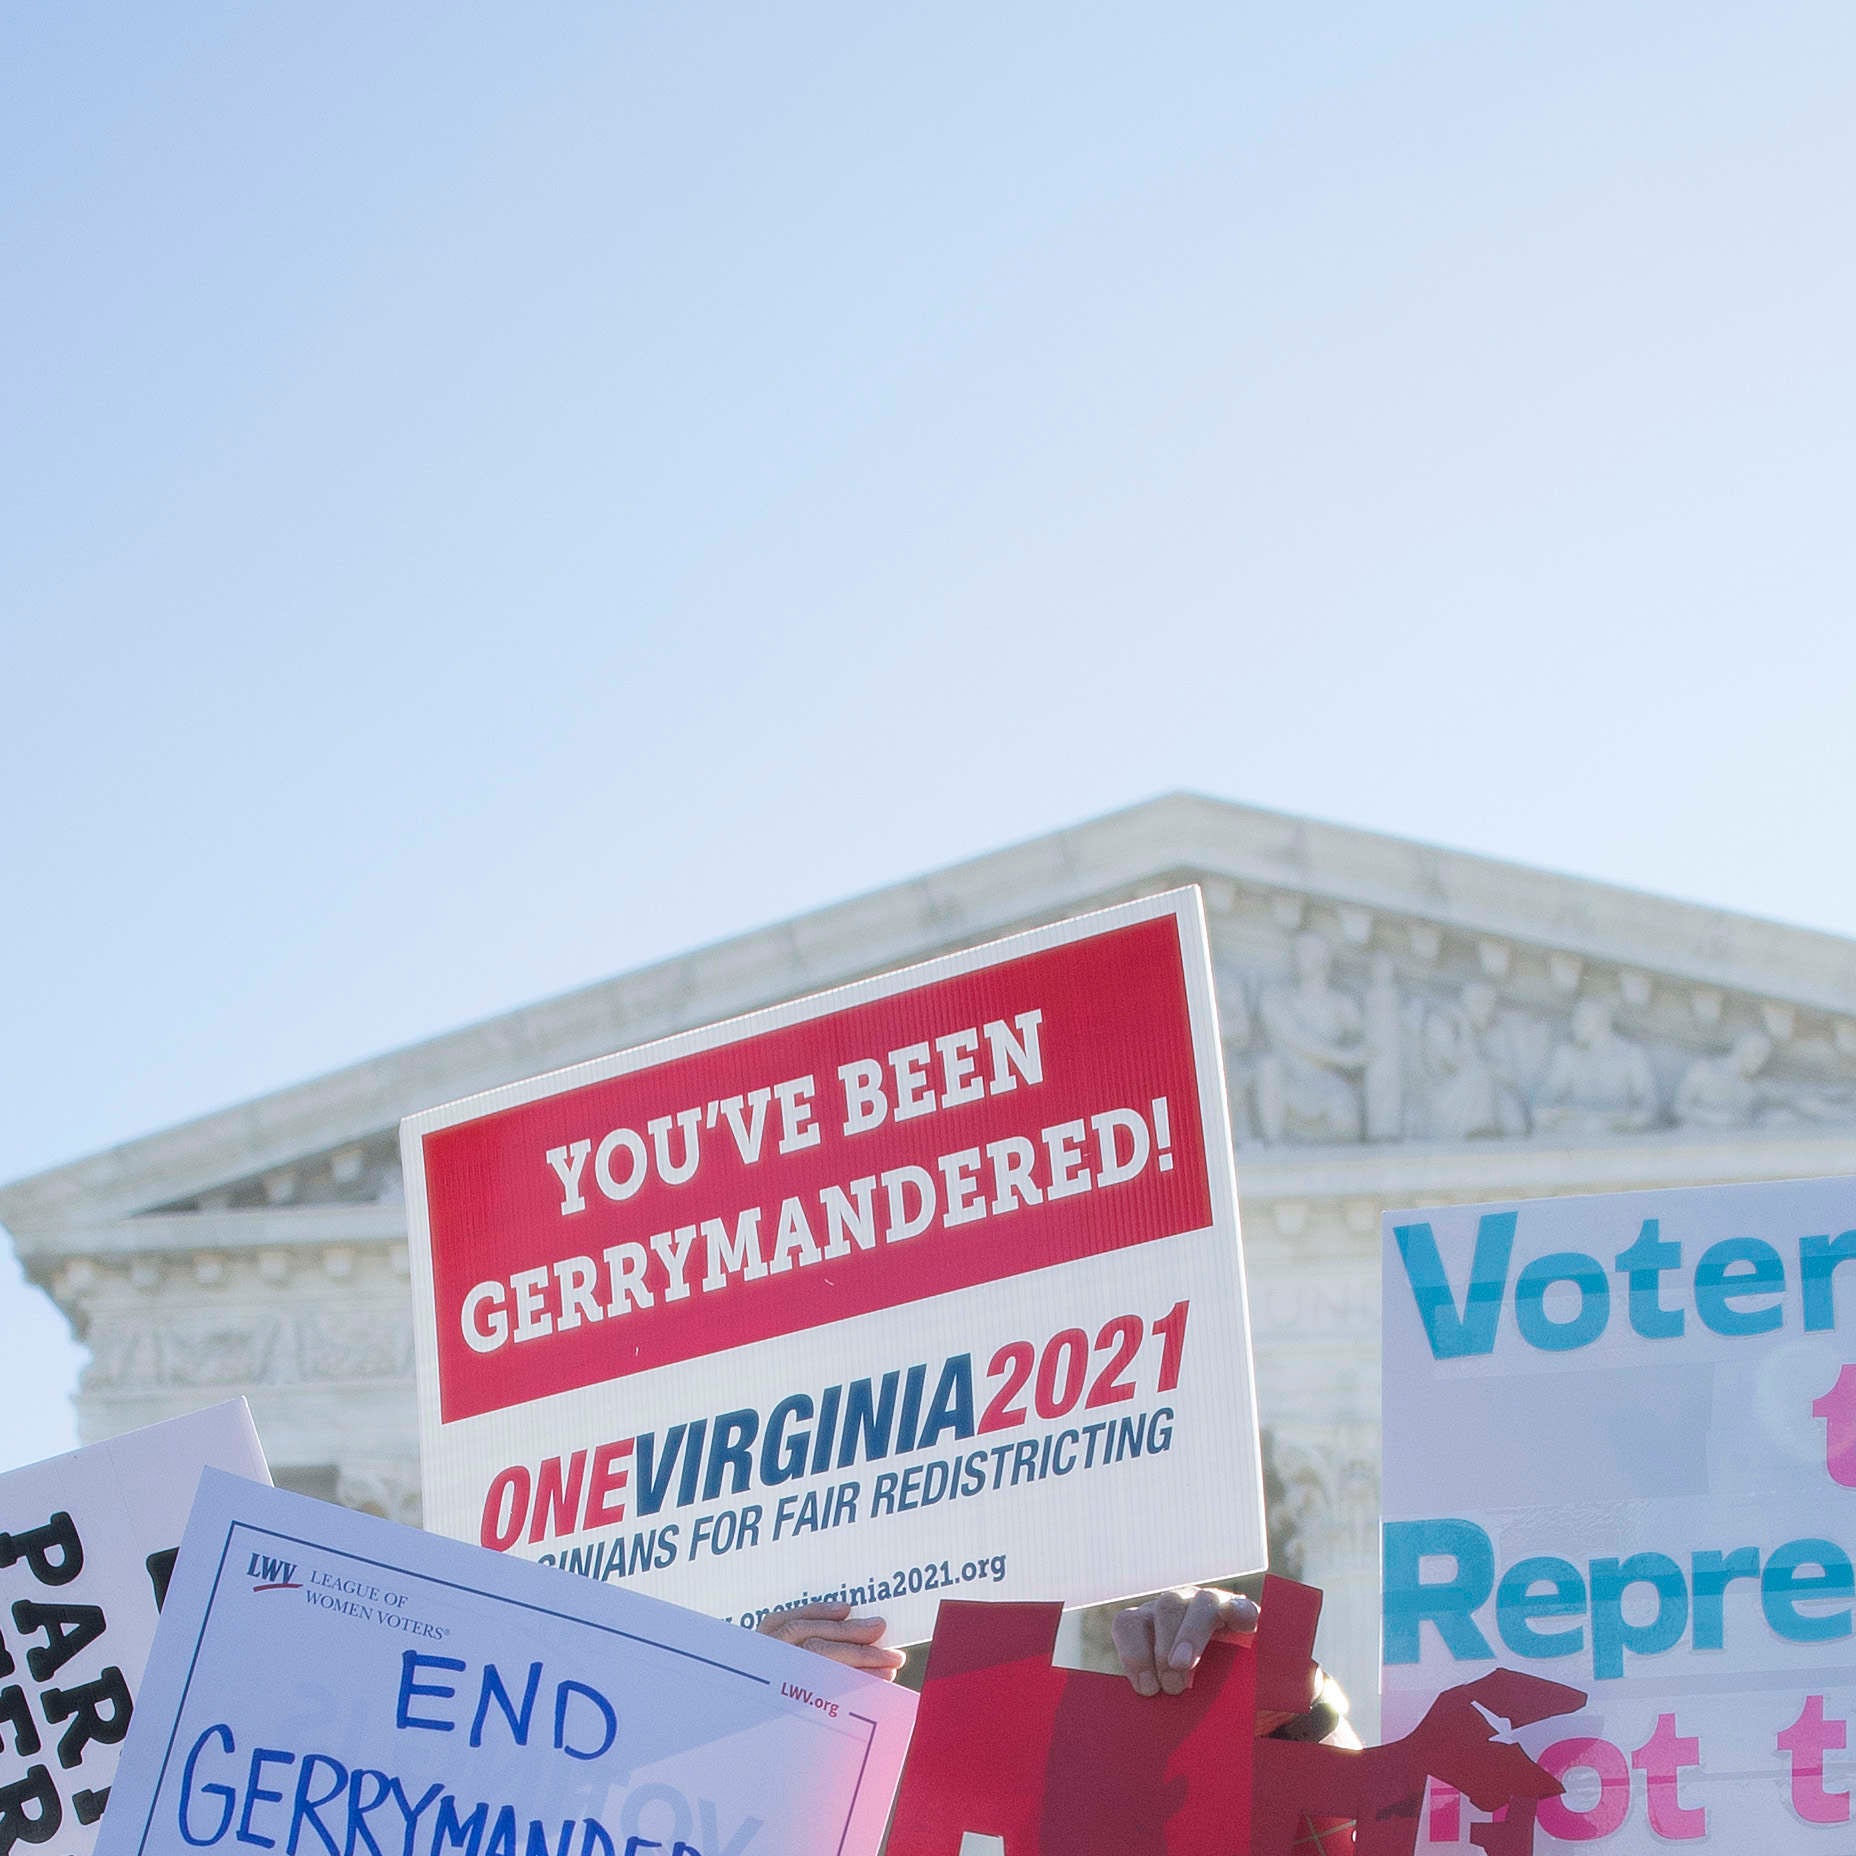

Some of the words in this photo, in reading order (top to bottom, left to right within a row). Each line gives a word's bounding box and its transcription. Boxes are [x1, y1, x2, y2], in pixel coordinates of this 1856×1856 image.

[546, 1075, 821, 1217] YOU'VE
[838, 1009, 1044, 1136] BEEN
[459, 1096, 1175, 1354] GERRYMANDERED!
[479, 1299, 1192, 1553] ONEVIRGINIA2021
[688, 1493, 760, 1561] FOR
[771, 1481, 857, 1544] FAIR
[870, 1407, 1174, 1519] REDISTRICTING
[247, 1552, 297, 1584] LWV
[305, 1590, 374, 1621] WOMEN
[310, 1570, 380, 1602] LEAGUE
[384, 1591, 408, 1609] OF
[396, 1650, 618, 1761] END
[781, 1681, 841, 1718] LWV.org
